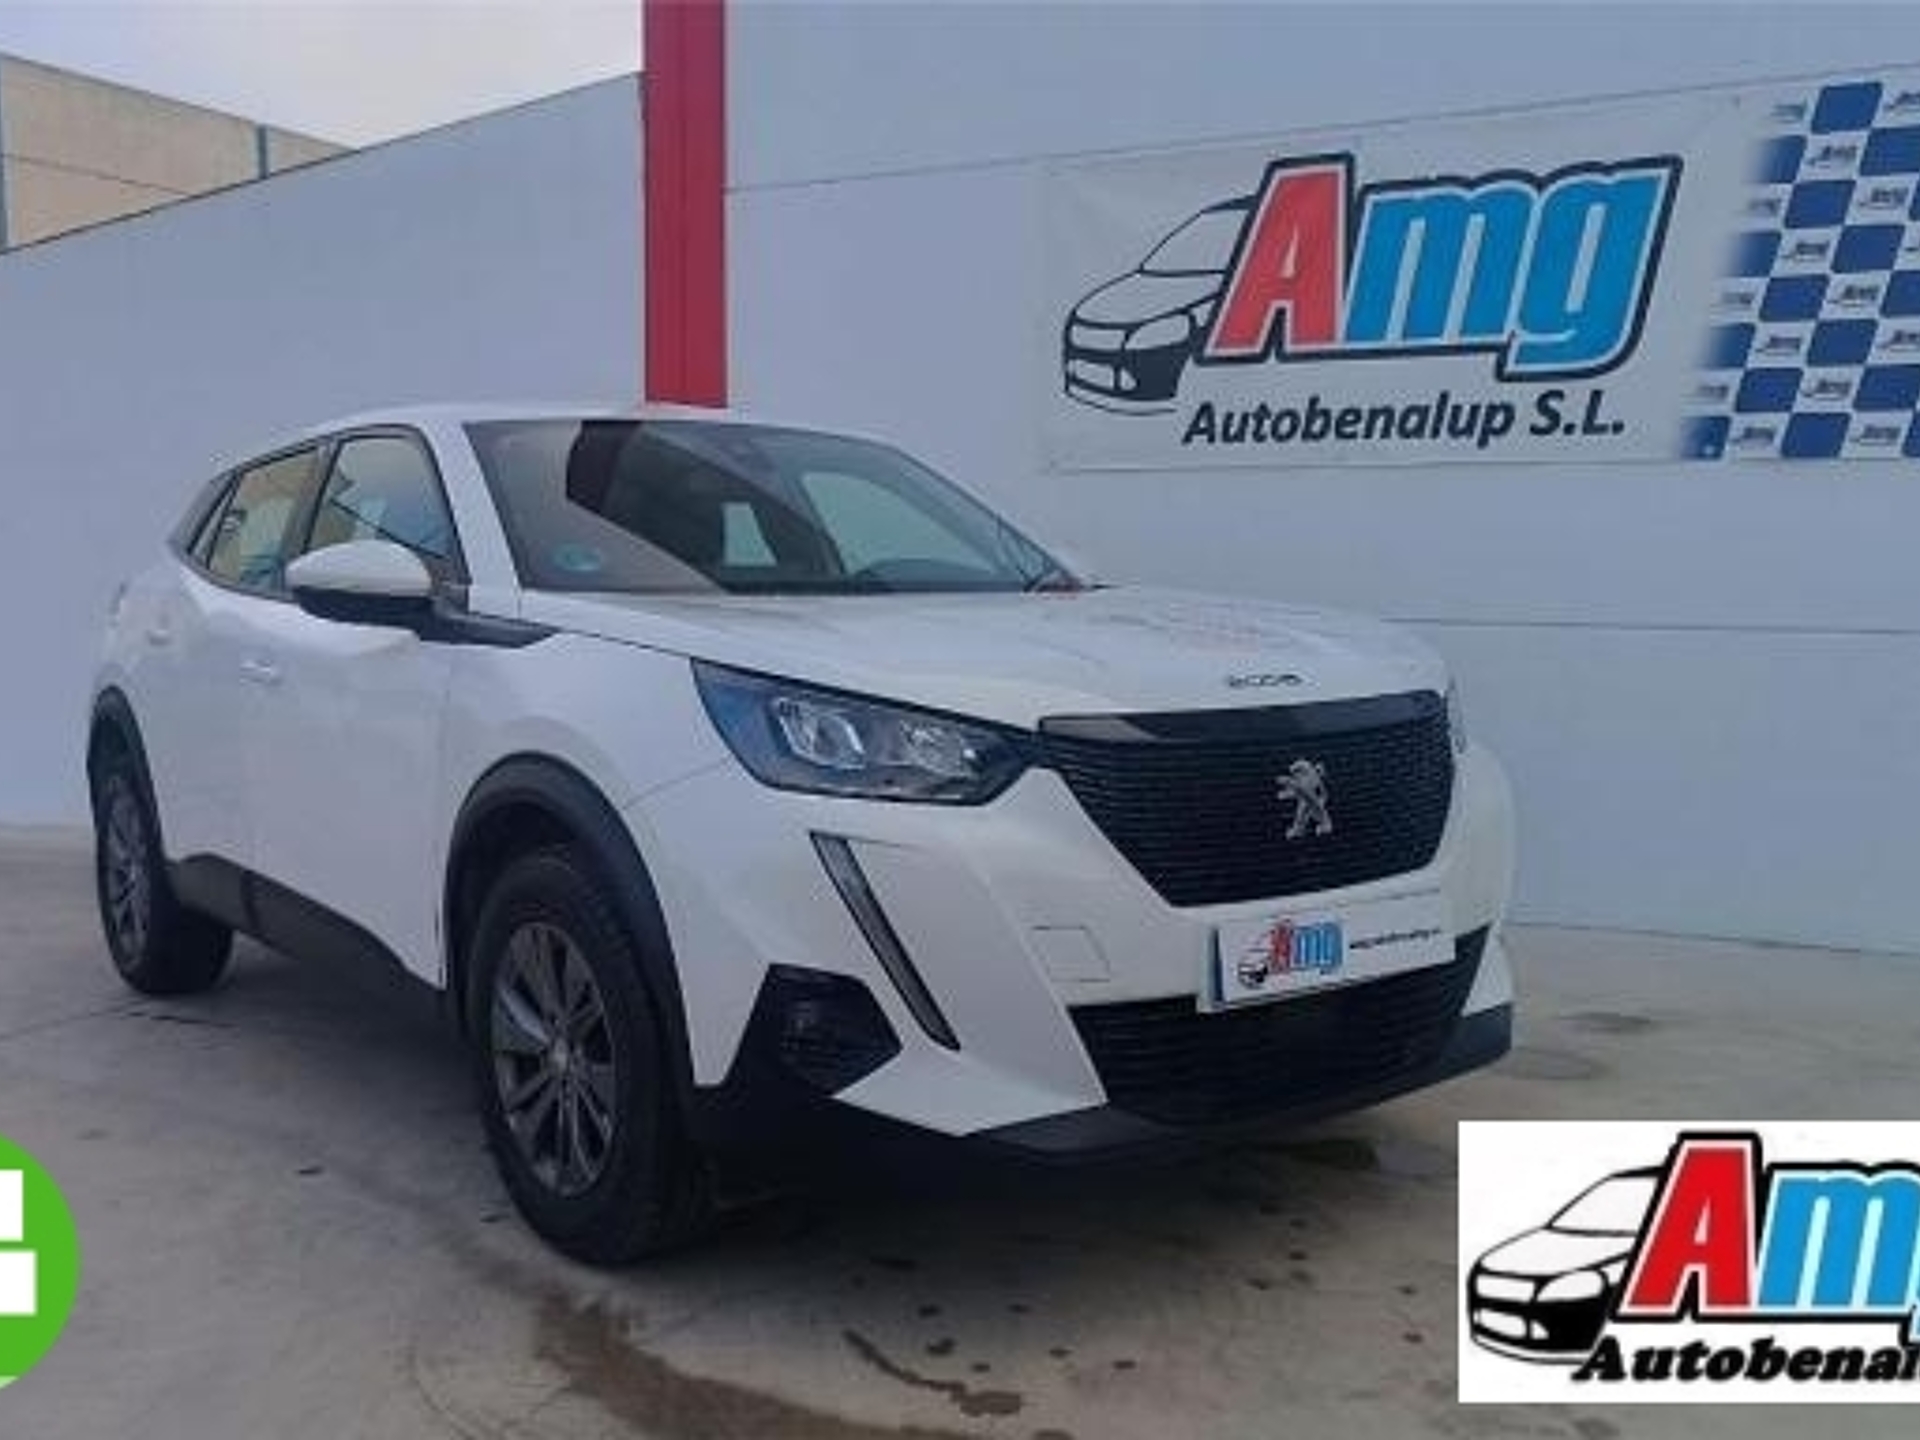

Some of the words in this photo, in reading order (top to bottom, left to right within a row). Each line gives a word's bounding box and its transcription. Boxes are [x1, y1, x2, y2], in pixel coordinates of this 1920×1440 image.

[1194, 151, 1684, 384] Amg
[1182, 396, 1515, 448] Autobenalup
[1529, 389, 1626, 438] S.L.
